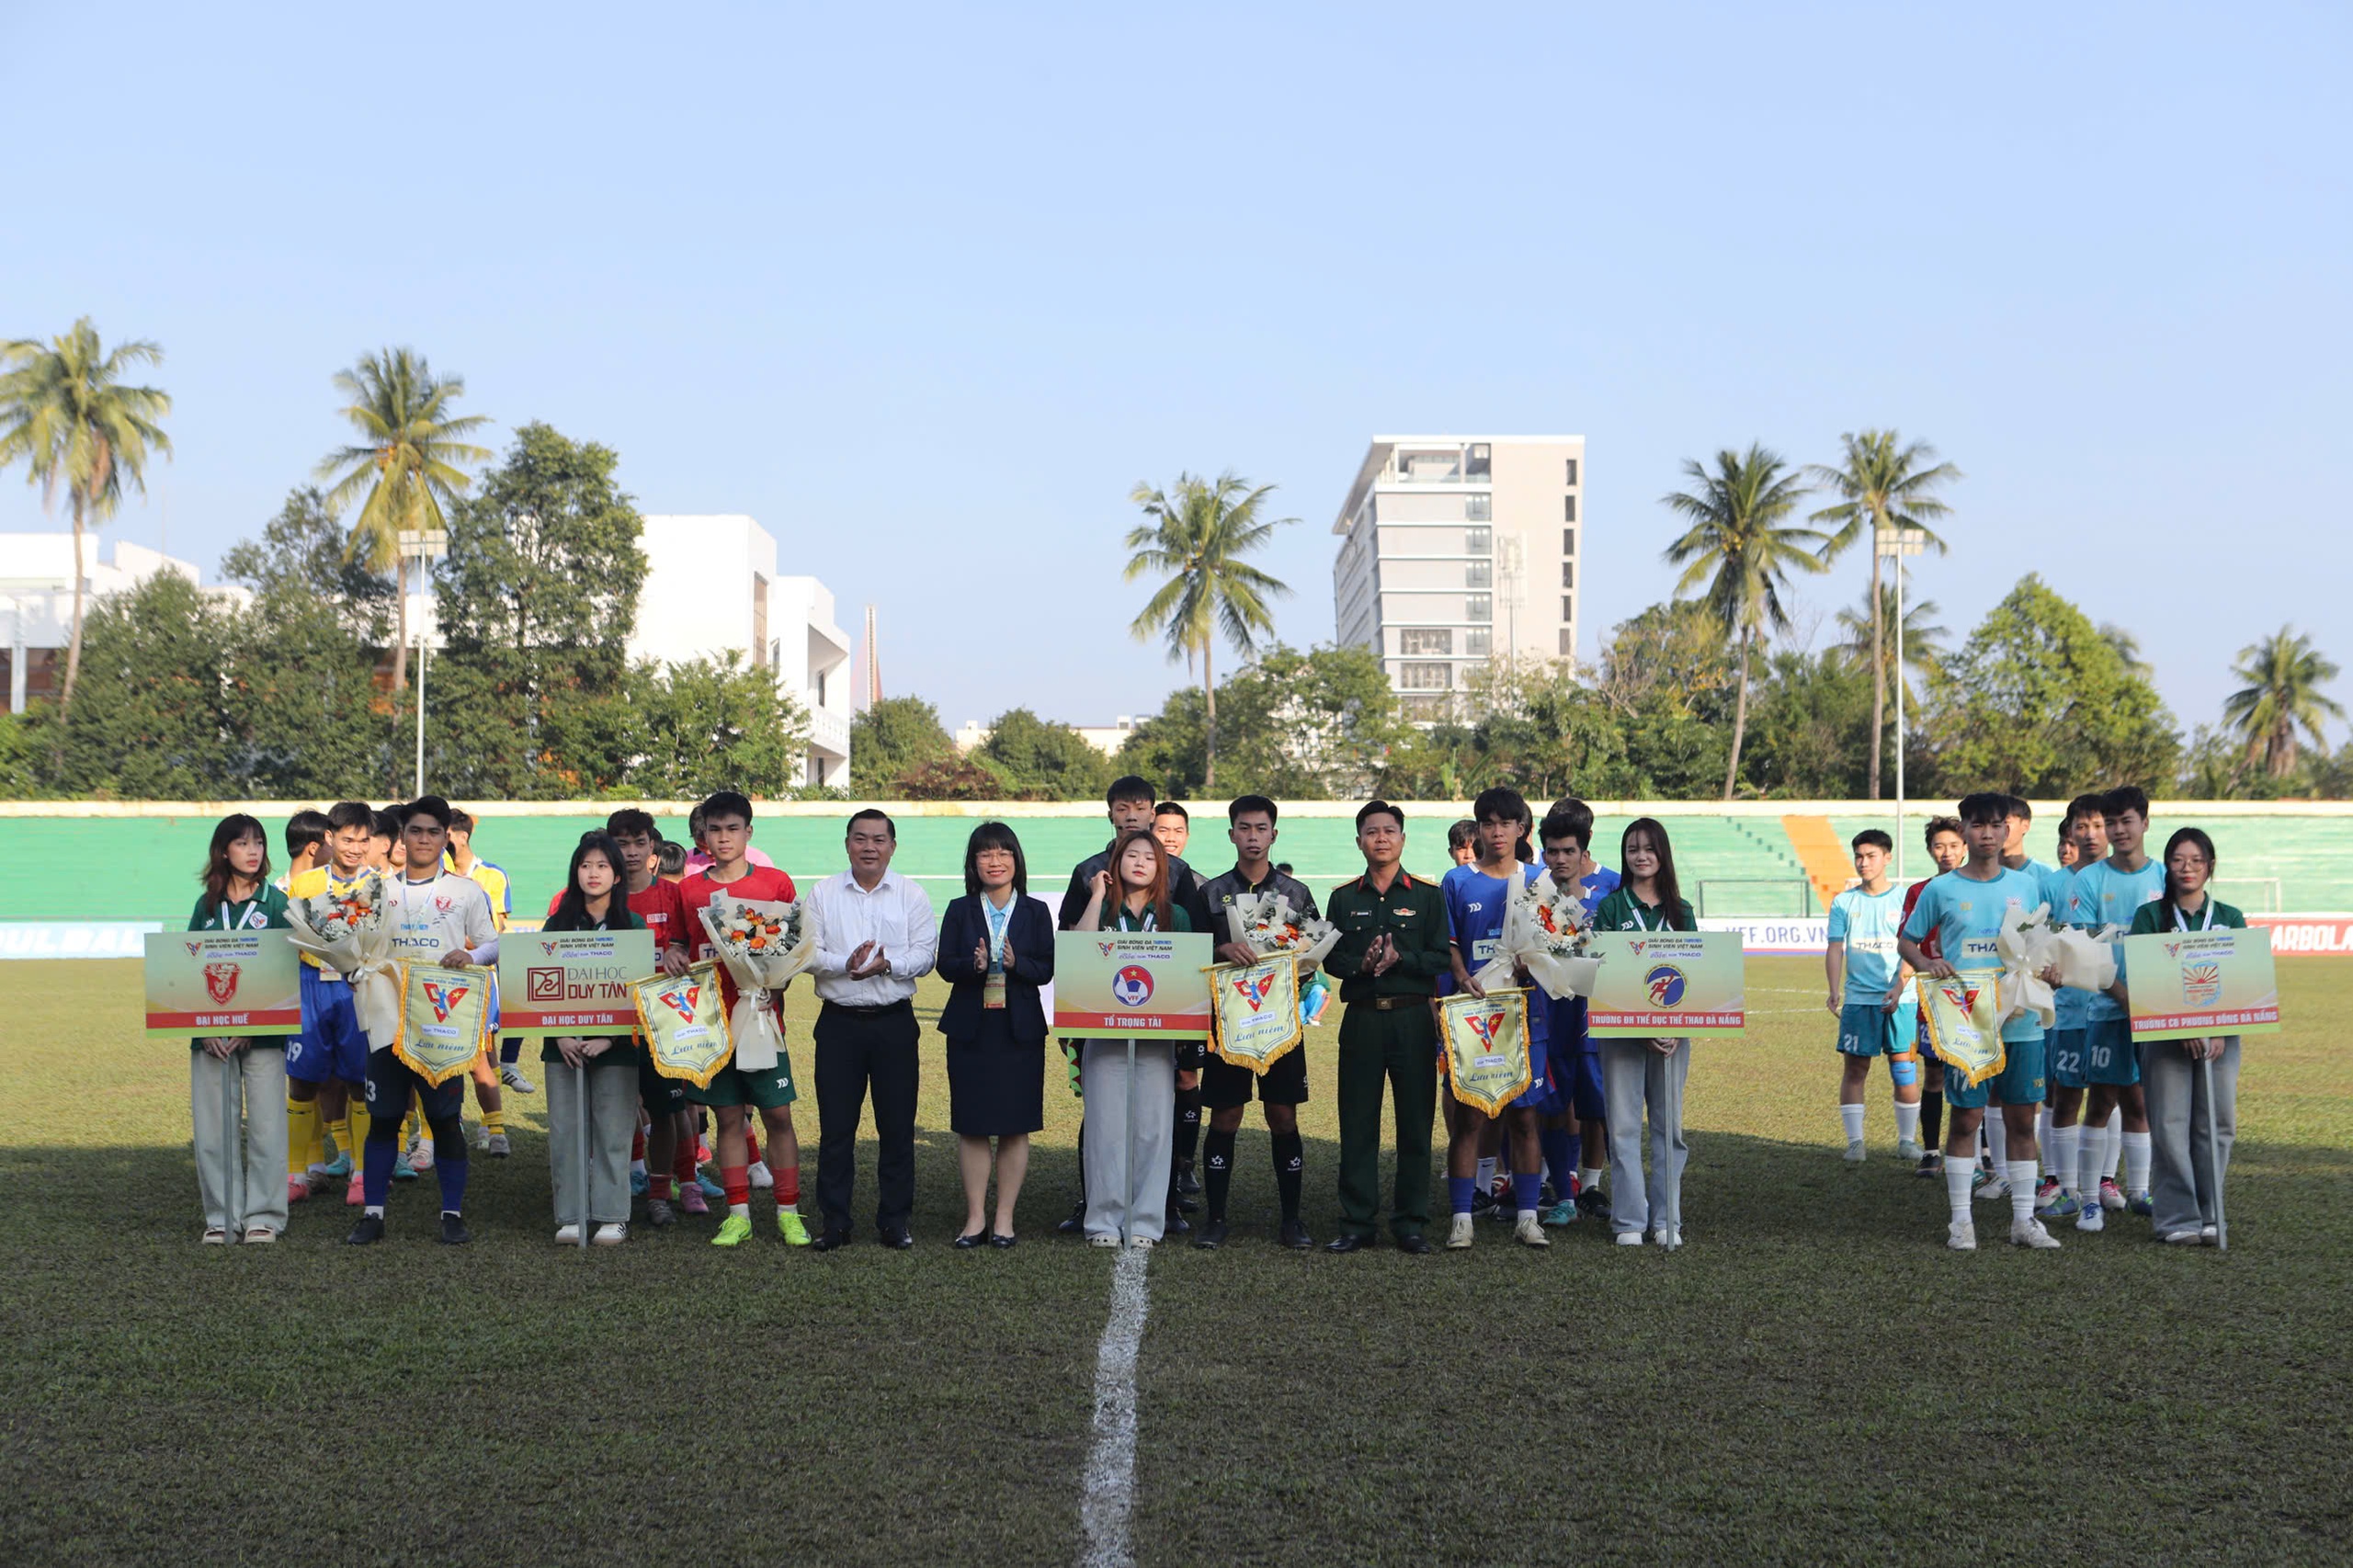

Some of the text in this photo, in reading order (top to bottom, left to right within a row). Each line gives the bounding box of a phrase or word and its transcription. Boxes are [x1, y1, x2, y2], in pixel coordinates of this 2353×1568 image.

[392, 937, 439, 948] THACO
[568, 981, 627, 999] DUY TÂN
[196, 1013, 250, 1027] ĐẠI HỌC HUẾ
[541, 1012, 613, 1027] ĐẠI HỌC DUY TÂN
[1117, 1017, 1146, 1028] TRỌNG
[1147, 1016, 1162, 1028] TÀI
[1591, 1014, 1622, 1025] TRƯỜNG
[1623, 1015, 1634, 1025] ĐH
[1652, 1016, 1667, 1026] DỤC
[1685, 1016, 1704, 1025] THAO
[1705, 1014, 1716, 1025] ĐÀ
[1844, 1033, 1859, 1051] 21
[287, 1040, 302, 1062] 19
[2090, 1045, 2111, 1068] 10
[2056, 1050, 2080, 1073] 22
